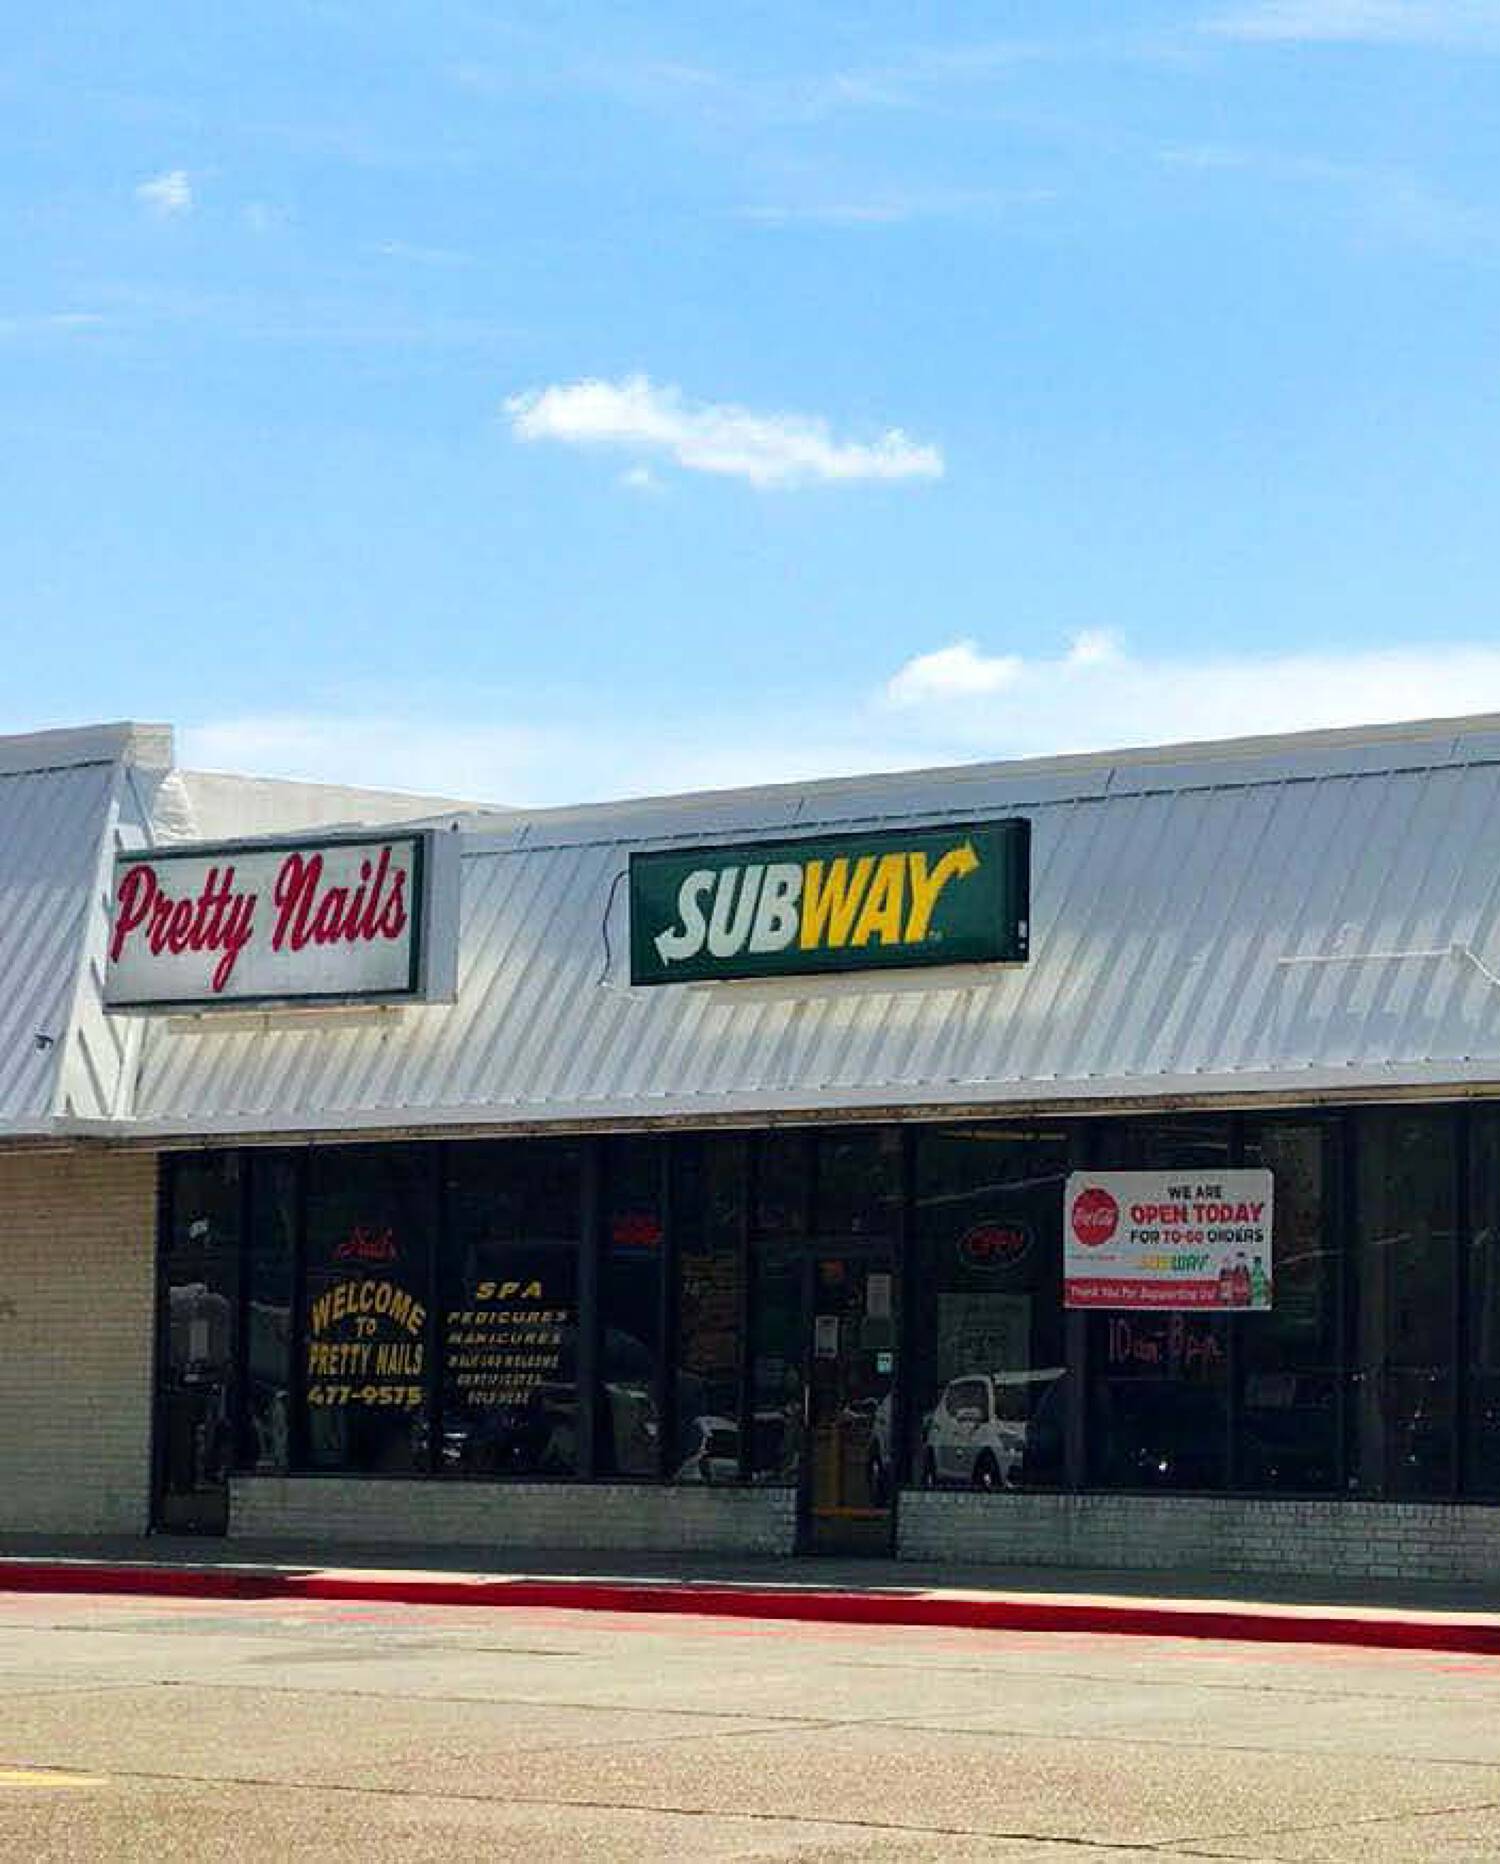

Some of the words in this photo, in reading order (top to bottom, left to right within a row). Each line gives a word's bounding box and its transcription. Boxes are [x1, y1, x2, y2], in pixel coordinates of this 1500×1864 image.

[653, 839, 981, 967] SUBWAY
[111, 863, 258, 993] Pretty
[272, 845, 406, 953] Nails
[1168, 1186, 1192, 1200] WE
[1196, 1185, 1223, 1199] ARE
[1130, 1205, 1188, 1224] OPEN
[1193, 1202, 1265, 1223] TODAY
[1131, 1229, 1160, 1244] FOR
[1164, 1229, 1204, 1244] TO-GO
[1207, 1228, 1264, 1244] ORDERS
[475, 1281, 542, 1299] SPA
[309, 1278, 427, 1336] WELCOME
[355, 1316, 377, 1338] TO
[308, 1343, 372, 1376] PRETTY
[376, 1342, 424, 1375] NAILS
